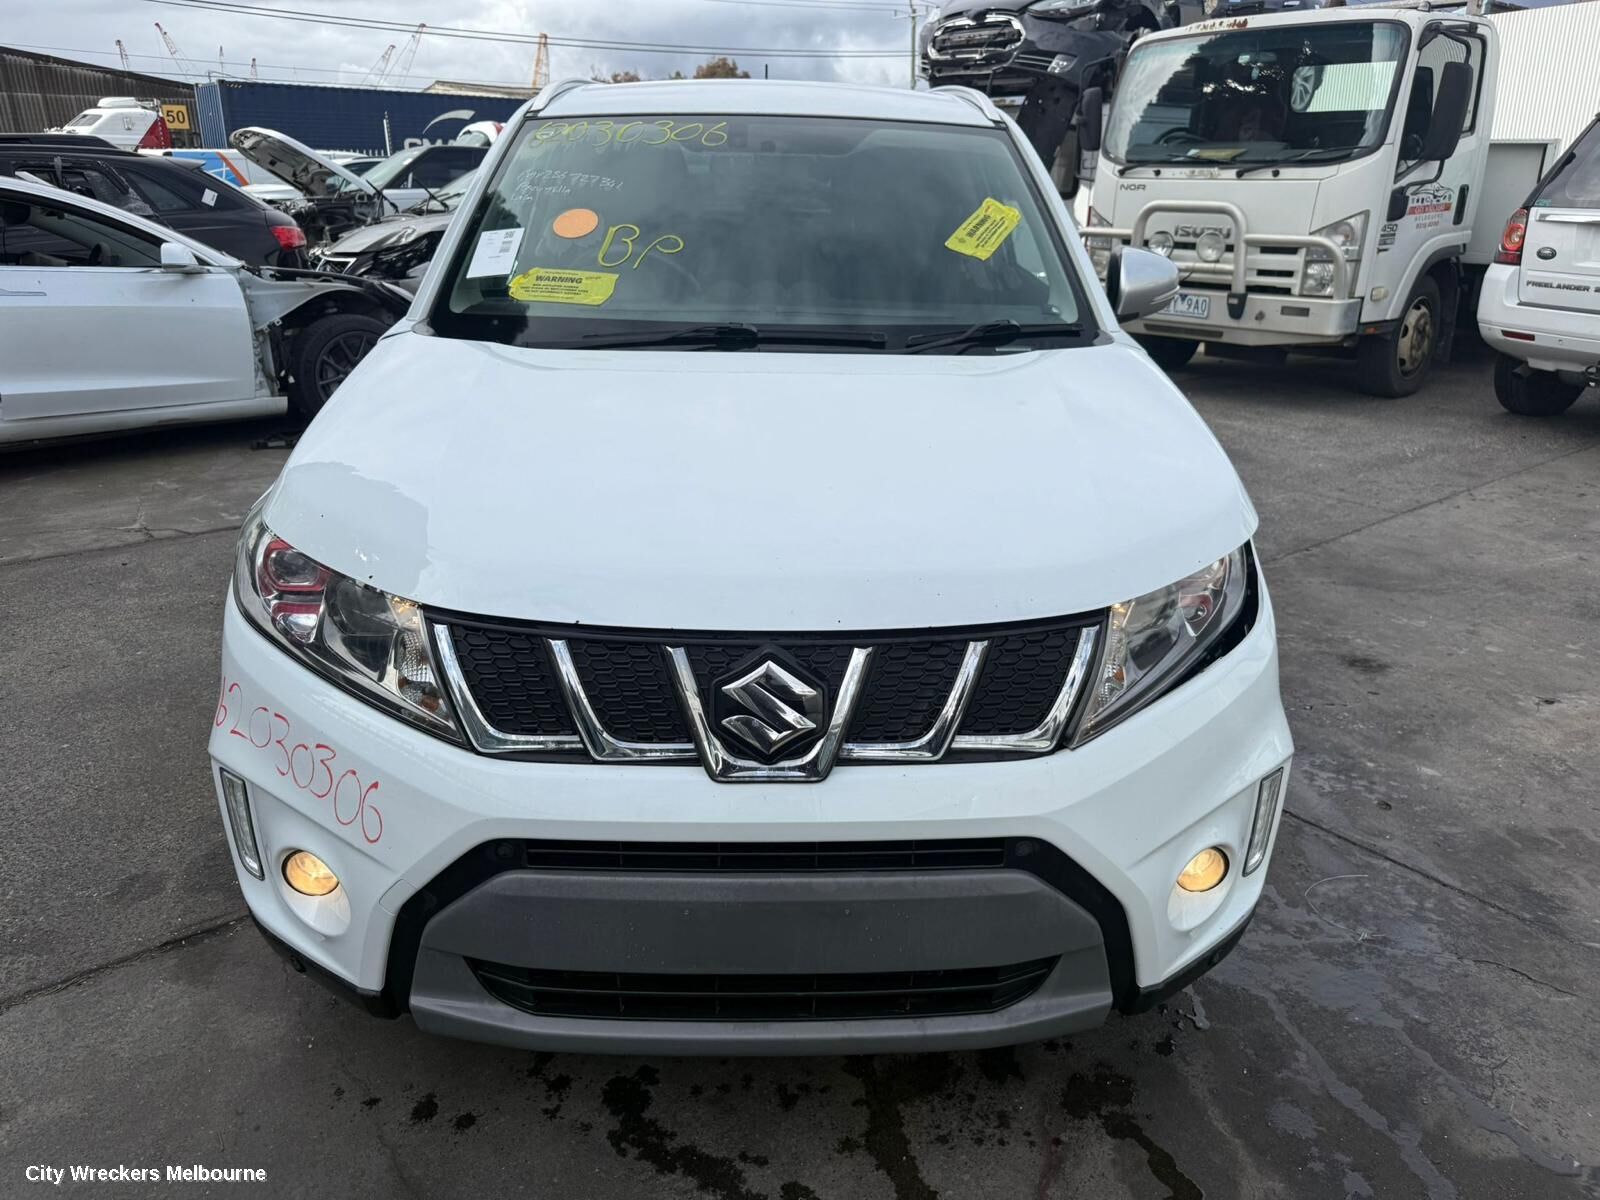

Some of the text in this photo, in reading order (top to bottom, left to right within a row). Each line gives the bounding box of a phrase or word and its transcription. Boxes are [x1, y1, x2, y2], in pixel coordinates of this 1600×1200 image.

[166, 110, 185, 124] 50
[535, 275, 583, 284] WARNING
[1526, 280, 1591, 292] FREELANDER
